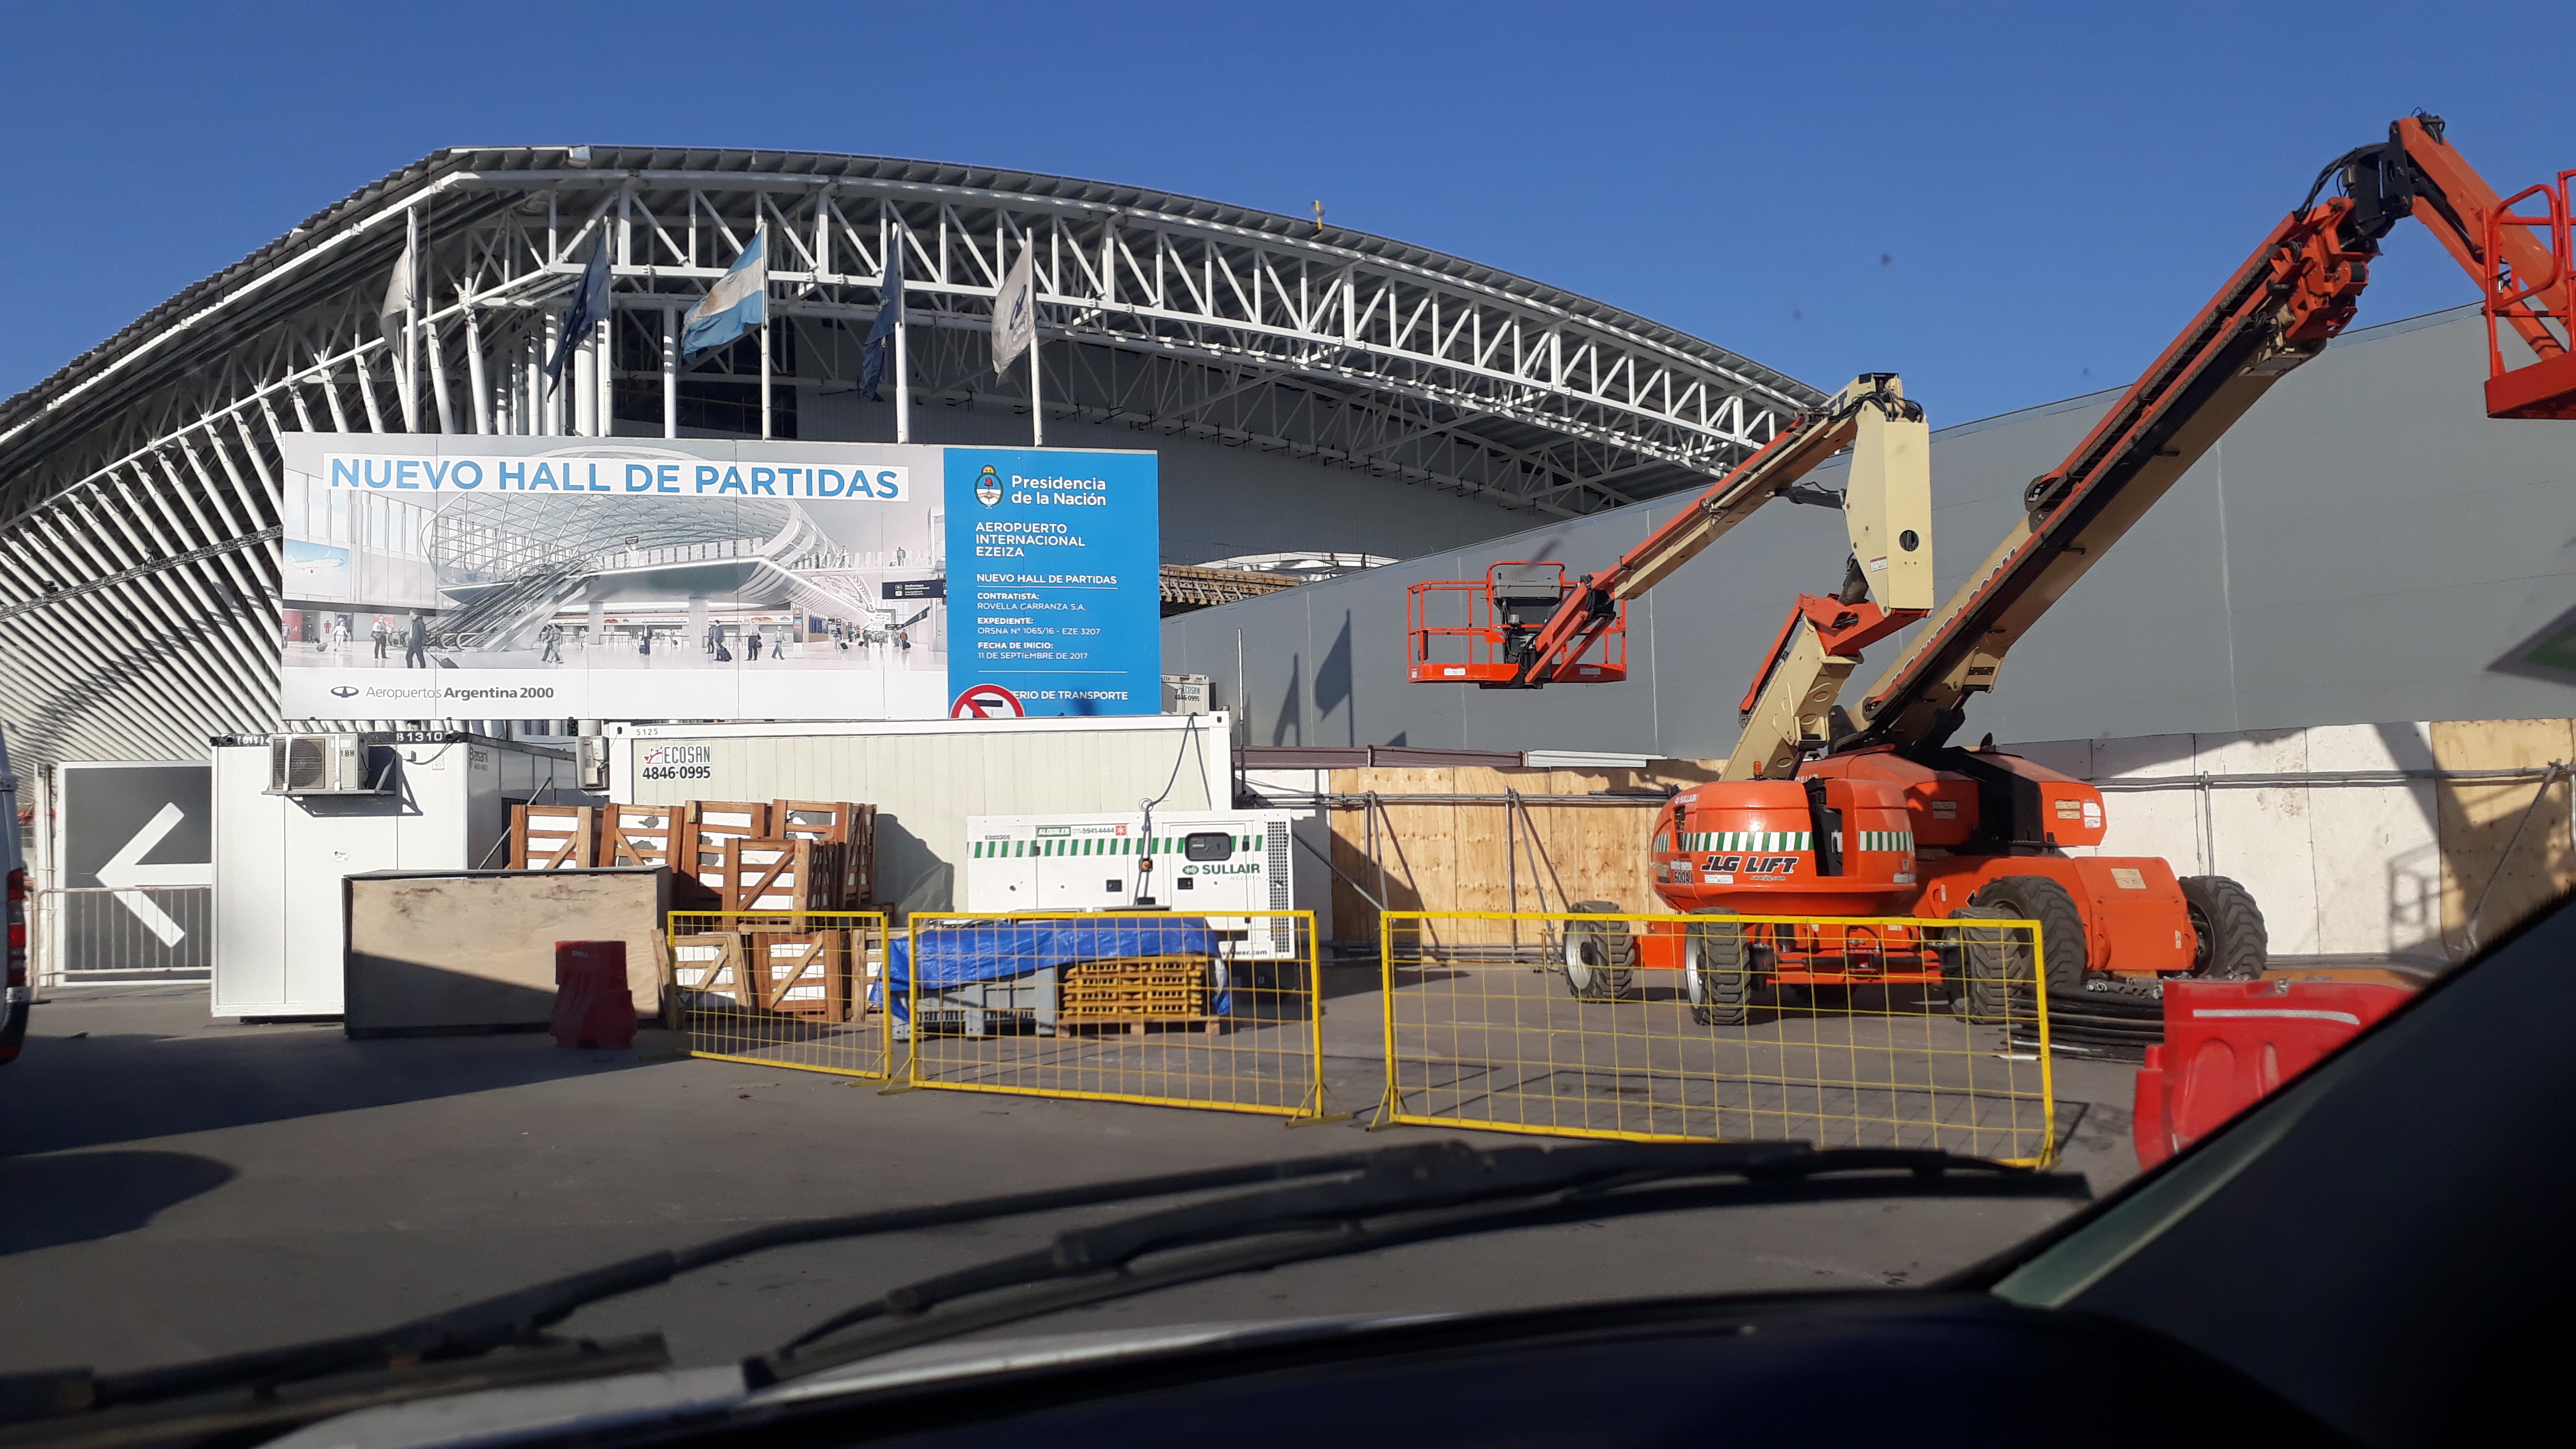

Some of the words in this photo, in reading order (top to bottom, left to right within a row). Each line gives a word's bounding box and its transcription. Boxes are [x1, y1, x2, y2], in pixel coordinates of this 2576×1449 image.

[332, 459, 482, 489] NUEVO
[499, 462, 610, 491] HALL
[626, 464, 680, 492] DE
[696, 466, 898, 498] PARTIDAS
[1012, 476, 1105, 490] Presidencia
[1012, 491, 1032, 504] de
[1037, 492, 1049, 504] la
[1054, 493, 1106, 505] Nación
[976, 522, 1066, 534] AEROPUERTO
[977, 535, 1085, 547] INTERNACIONAL
[977, 547, 1024, 557] EZEIZA
[977, 574, 1014, 583] NUEVO
[1018, 575, 1046, 583] HALL
[1066, 575, 1116, 583] PARTIDAS
[366, 686, 441, 699] Aeropuertos
[444, 687, 517, 701] Argentina
[520, 688, 554, 698] 2000
[1042, 691, 1055, 699] DE
[1058, 690, 1128, 700] TRANSPORTE
[396, 732, 442, 742] B1310
[664, 746, 710, 763] ECOSAN
[643, 766, 710, 779] 4846-0995
[1202, 864, 1260, 874] SULLAIR
[1700, 856, 1742, 872] JLG
[1744, 857, 1798, 874] LIFT
[1674, 871, 1694, 884] 600AJ
